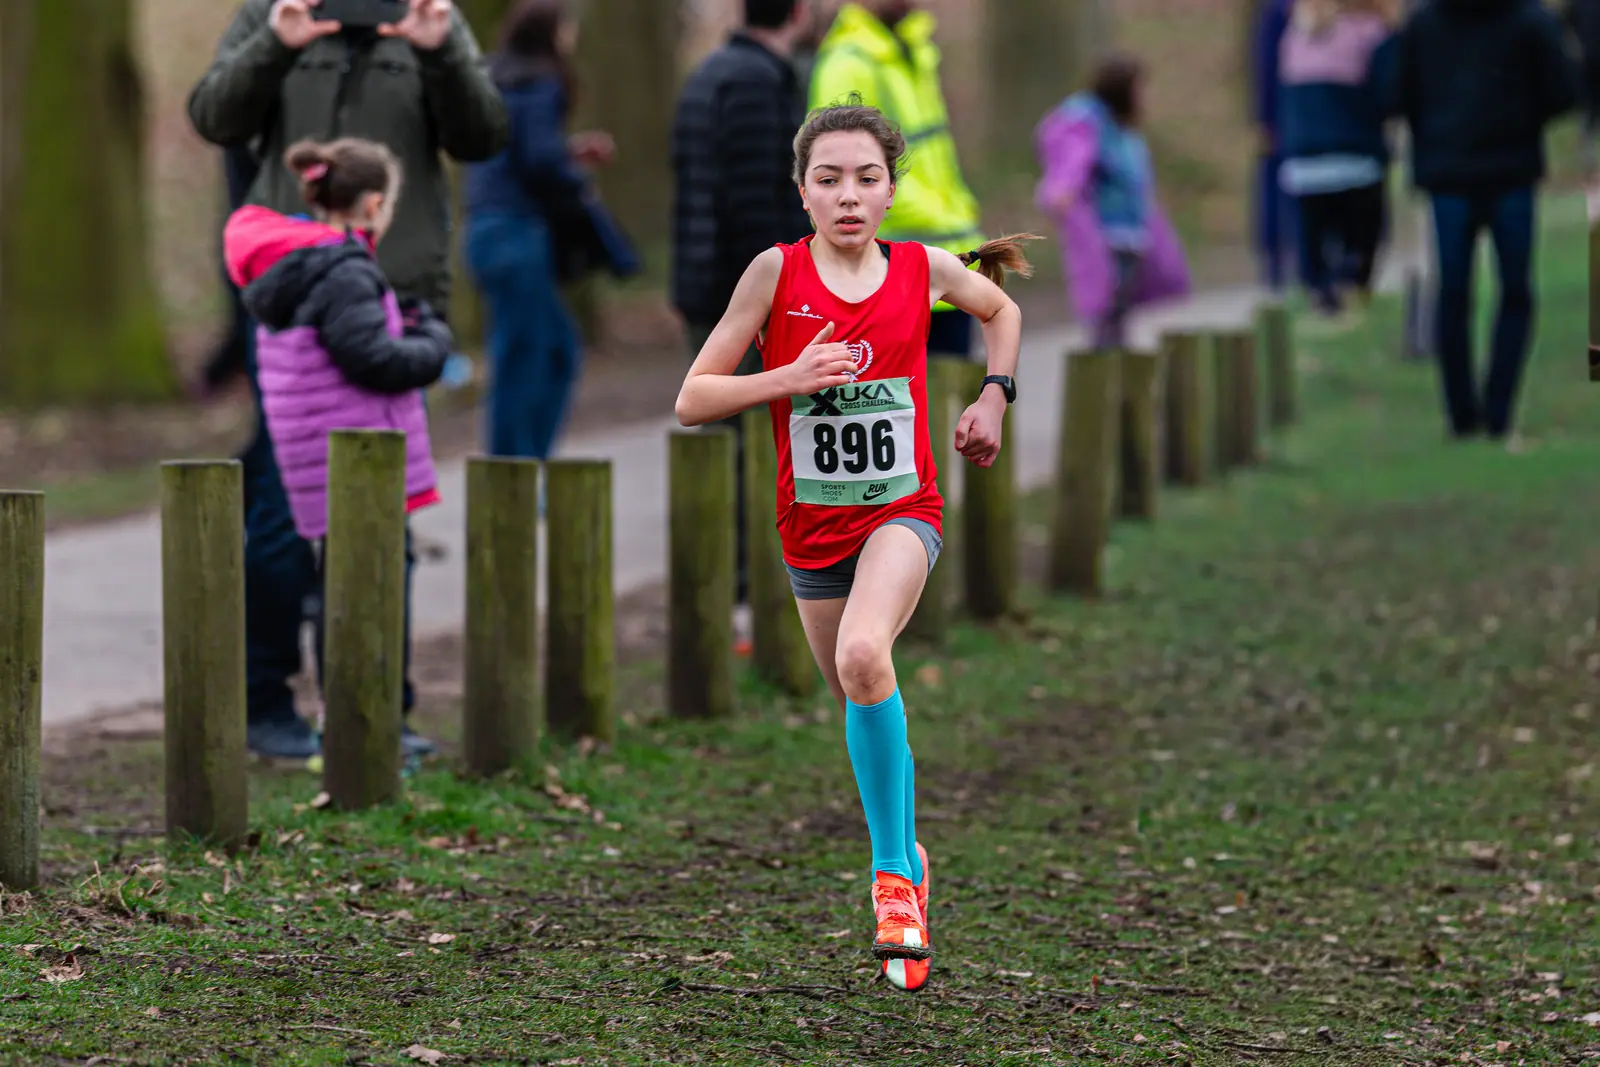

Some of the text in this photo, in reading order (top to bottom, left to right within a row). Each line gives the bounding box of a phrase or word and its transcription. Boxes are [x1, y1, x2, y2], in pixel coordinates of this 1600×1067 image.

[839, 383, 894, 402] UKA
[840, 398, 896, 410] CROSS CHALLENGE
[813, 419, 896, 474] 896
[867, 482, 889, 493] RUN
